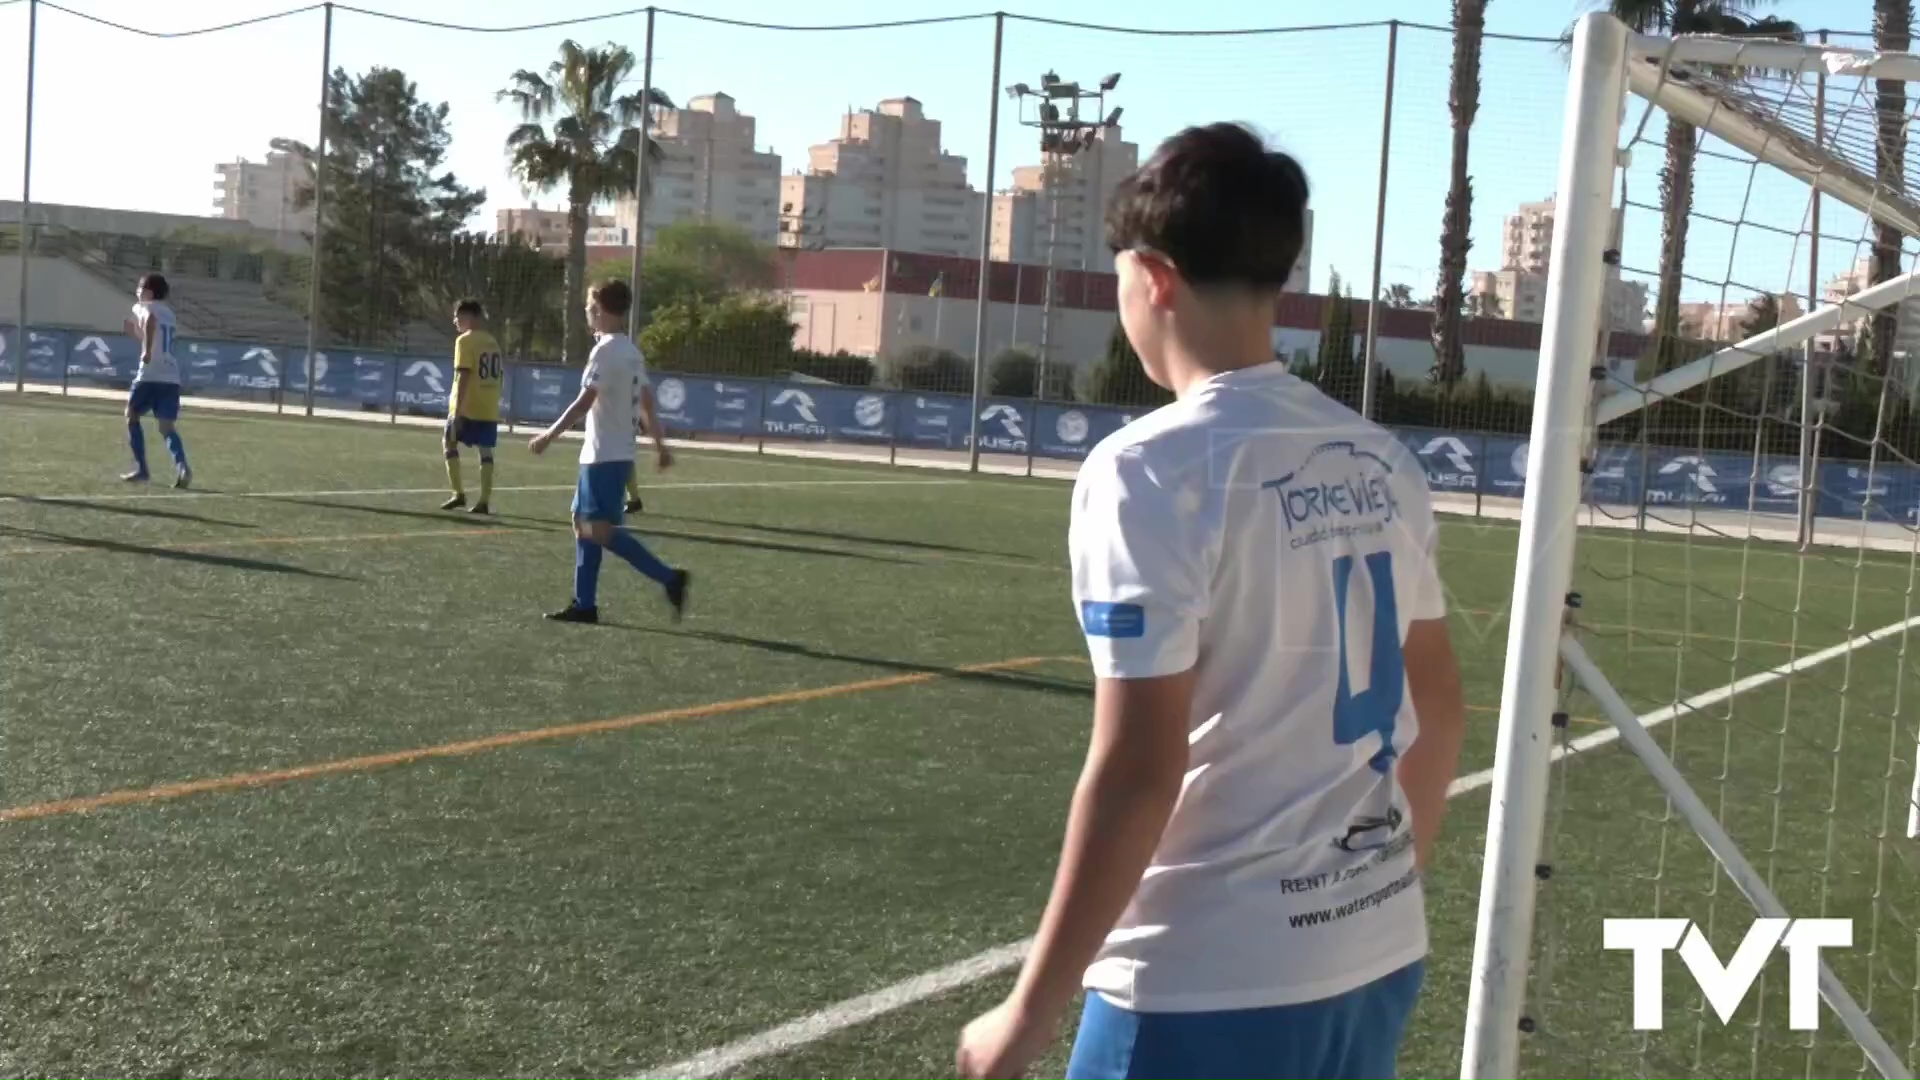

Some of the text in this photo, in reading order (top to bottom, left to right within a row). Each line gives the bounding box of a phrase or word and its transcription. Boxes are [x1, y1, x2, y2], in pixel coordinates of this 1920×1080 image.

[1428, 471, 1477, 488] USA
[1332, 551, 1405, 774] 4
[1280, 872, 1328, 895] RENT
